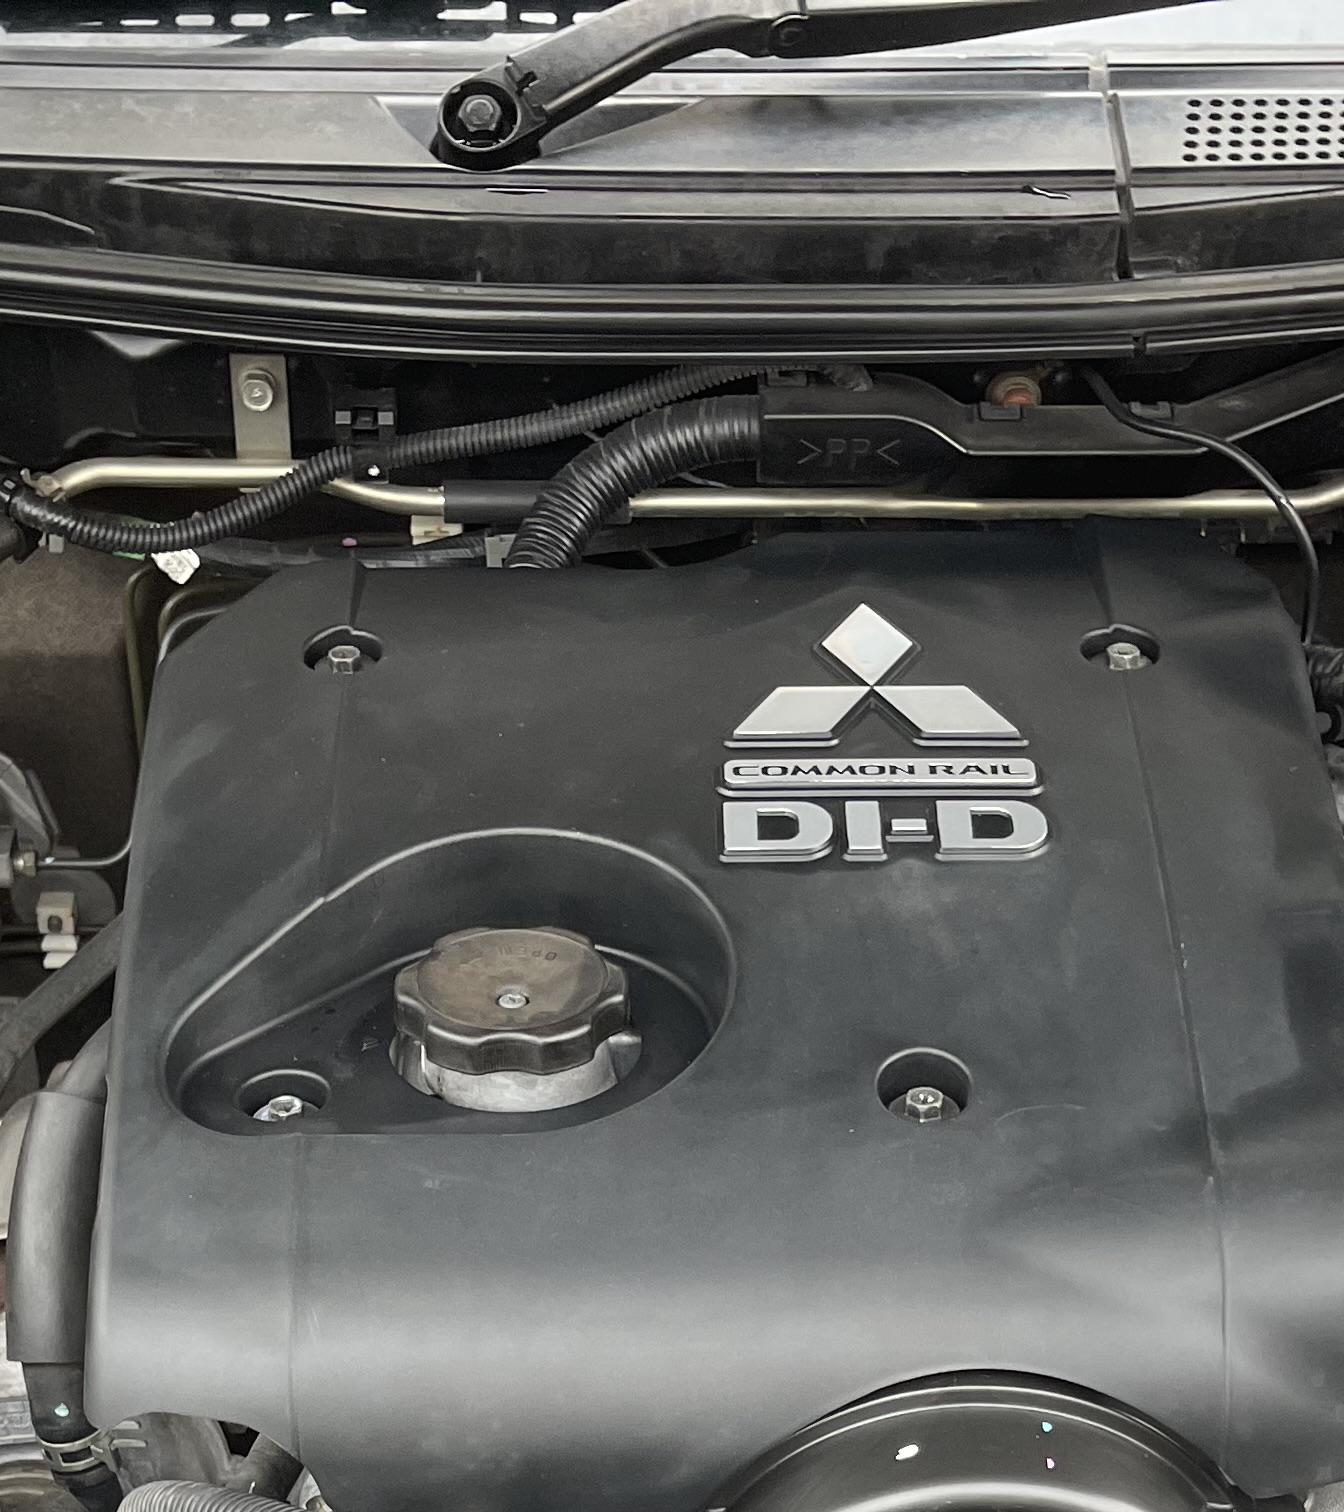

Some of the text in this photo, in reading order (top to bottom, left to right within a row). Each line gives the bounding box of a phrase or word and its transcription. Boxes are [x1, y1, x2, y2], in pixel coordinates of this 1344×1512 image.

[732, 763, 1030, 777] COMMON RAIL
[722, 800, 1049, 862] DI-D
